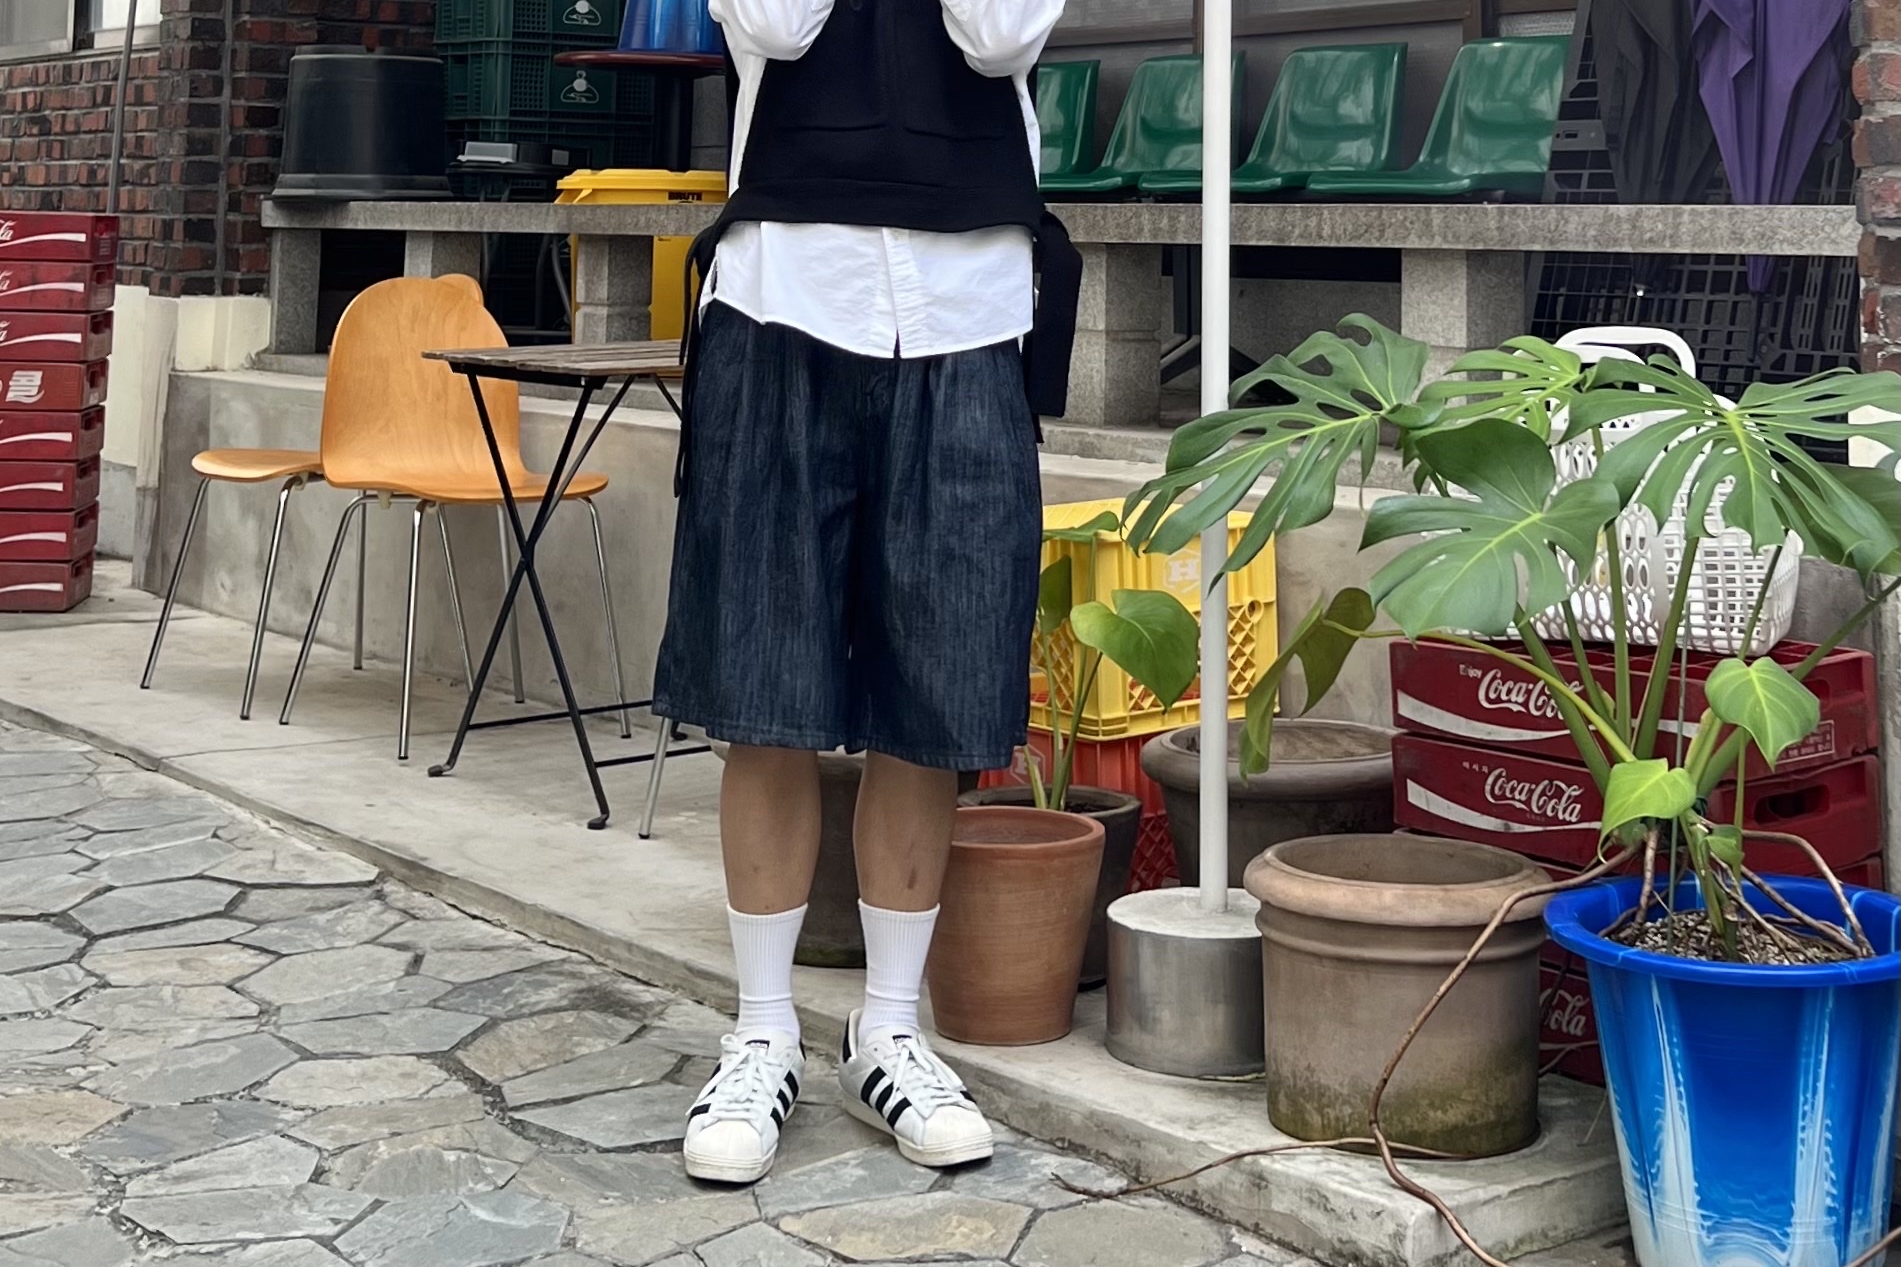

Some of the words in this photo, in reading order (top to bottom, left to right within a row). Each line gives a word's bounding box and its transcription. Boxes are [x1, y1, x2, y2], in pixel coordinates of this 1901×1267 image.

[668, 192, 702, 200] BRUTE
[1459, 664, 1482, 679] Enjoy
[1484, 767, 1585, 822] Coca-Cola
